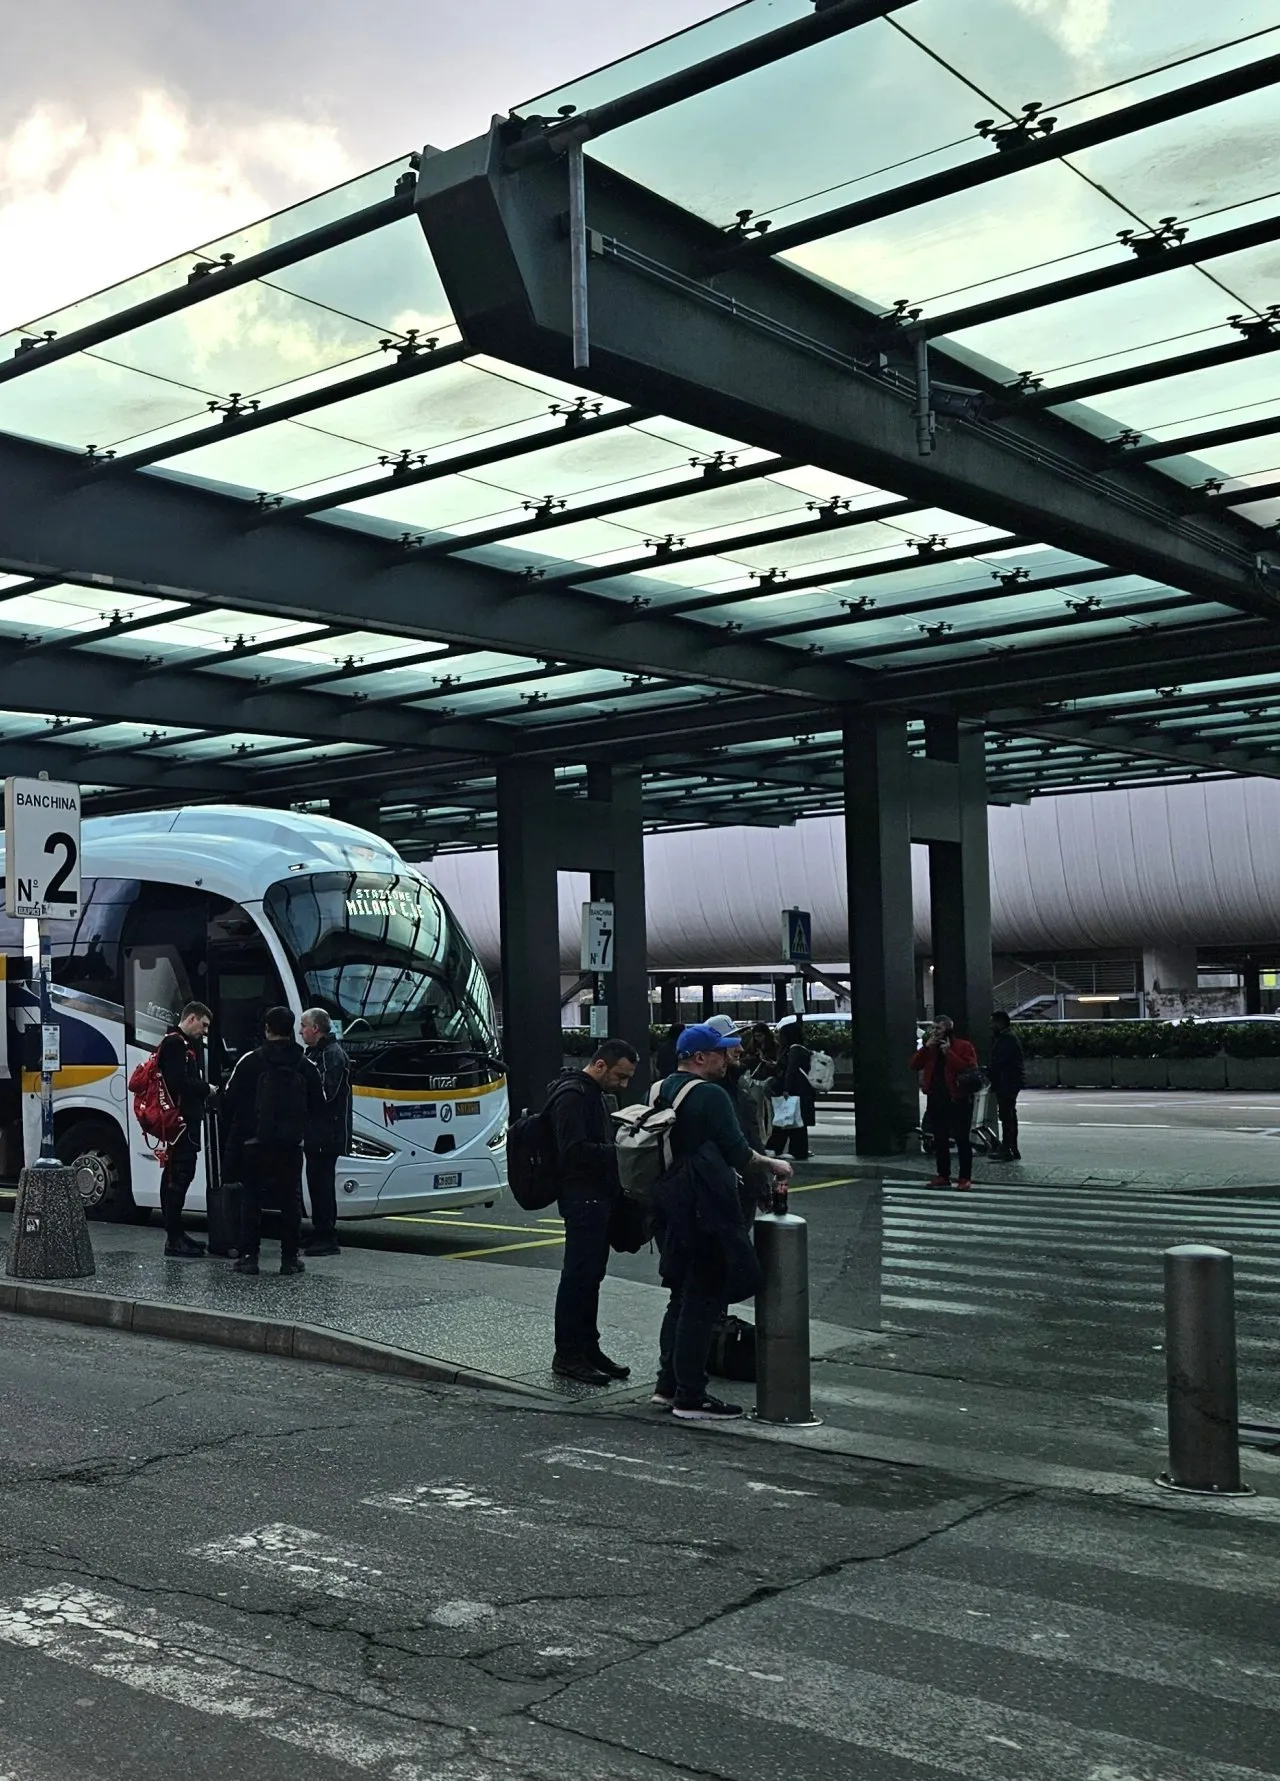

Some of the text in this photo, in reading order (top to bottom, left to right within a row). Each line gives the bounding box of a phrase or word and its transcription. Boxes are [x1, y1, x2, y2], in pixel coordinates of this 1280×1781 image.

[16, 792, 77, 812] BANCHINA
[43, 831, 78, 905] 2
[355, 888, 413, 902] STAZIONE
[345, 899, 397, 916] MILANO
[590, 908, 613, 917] BANCHINA
[599, 929, 612, 965] 7
